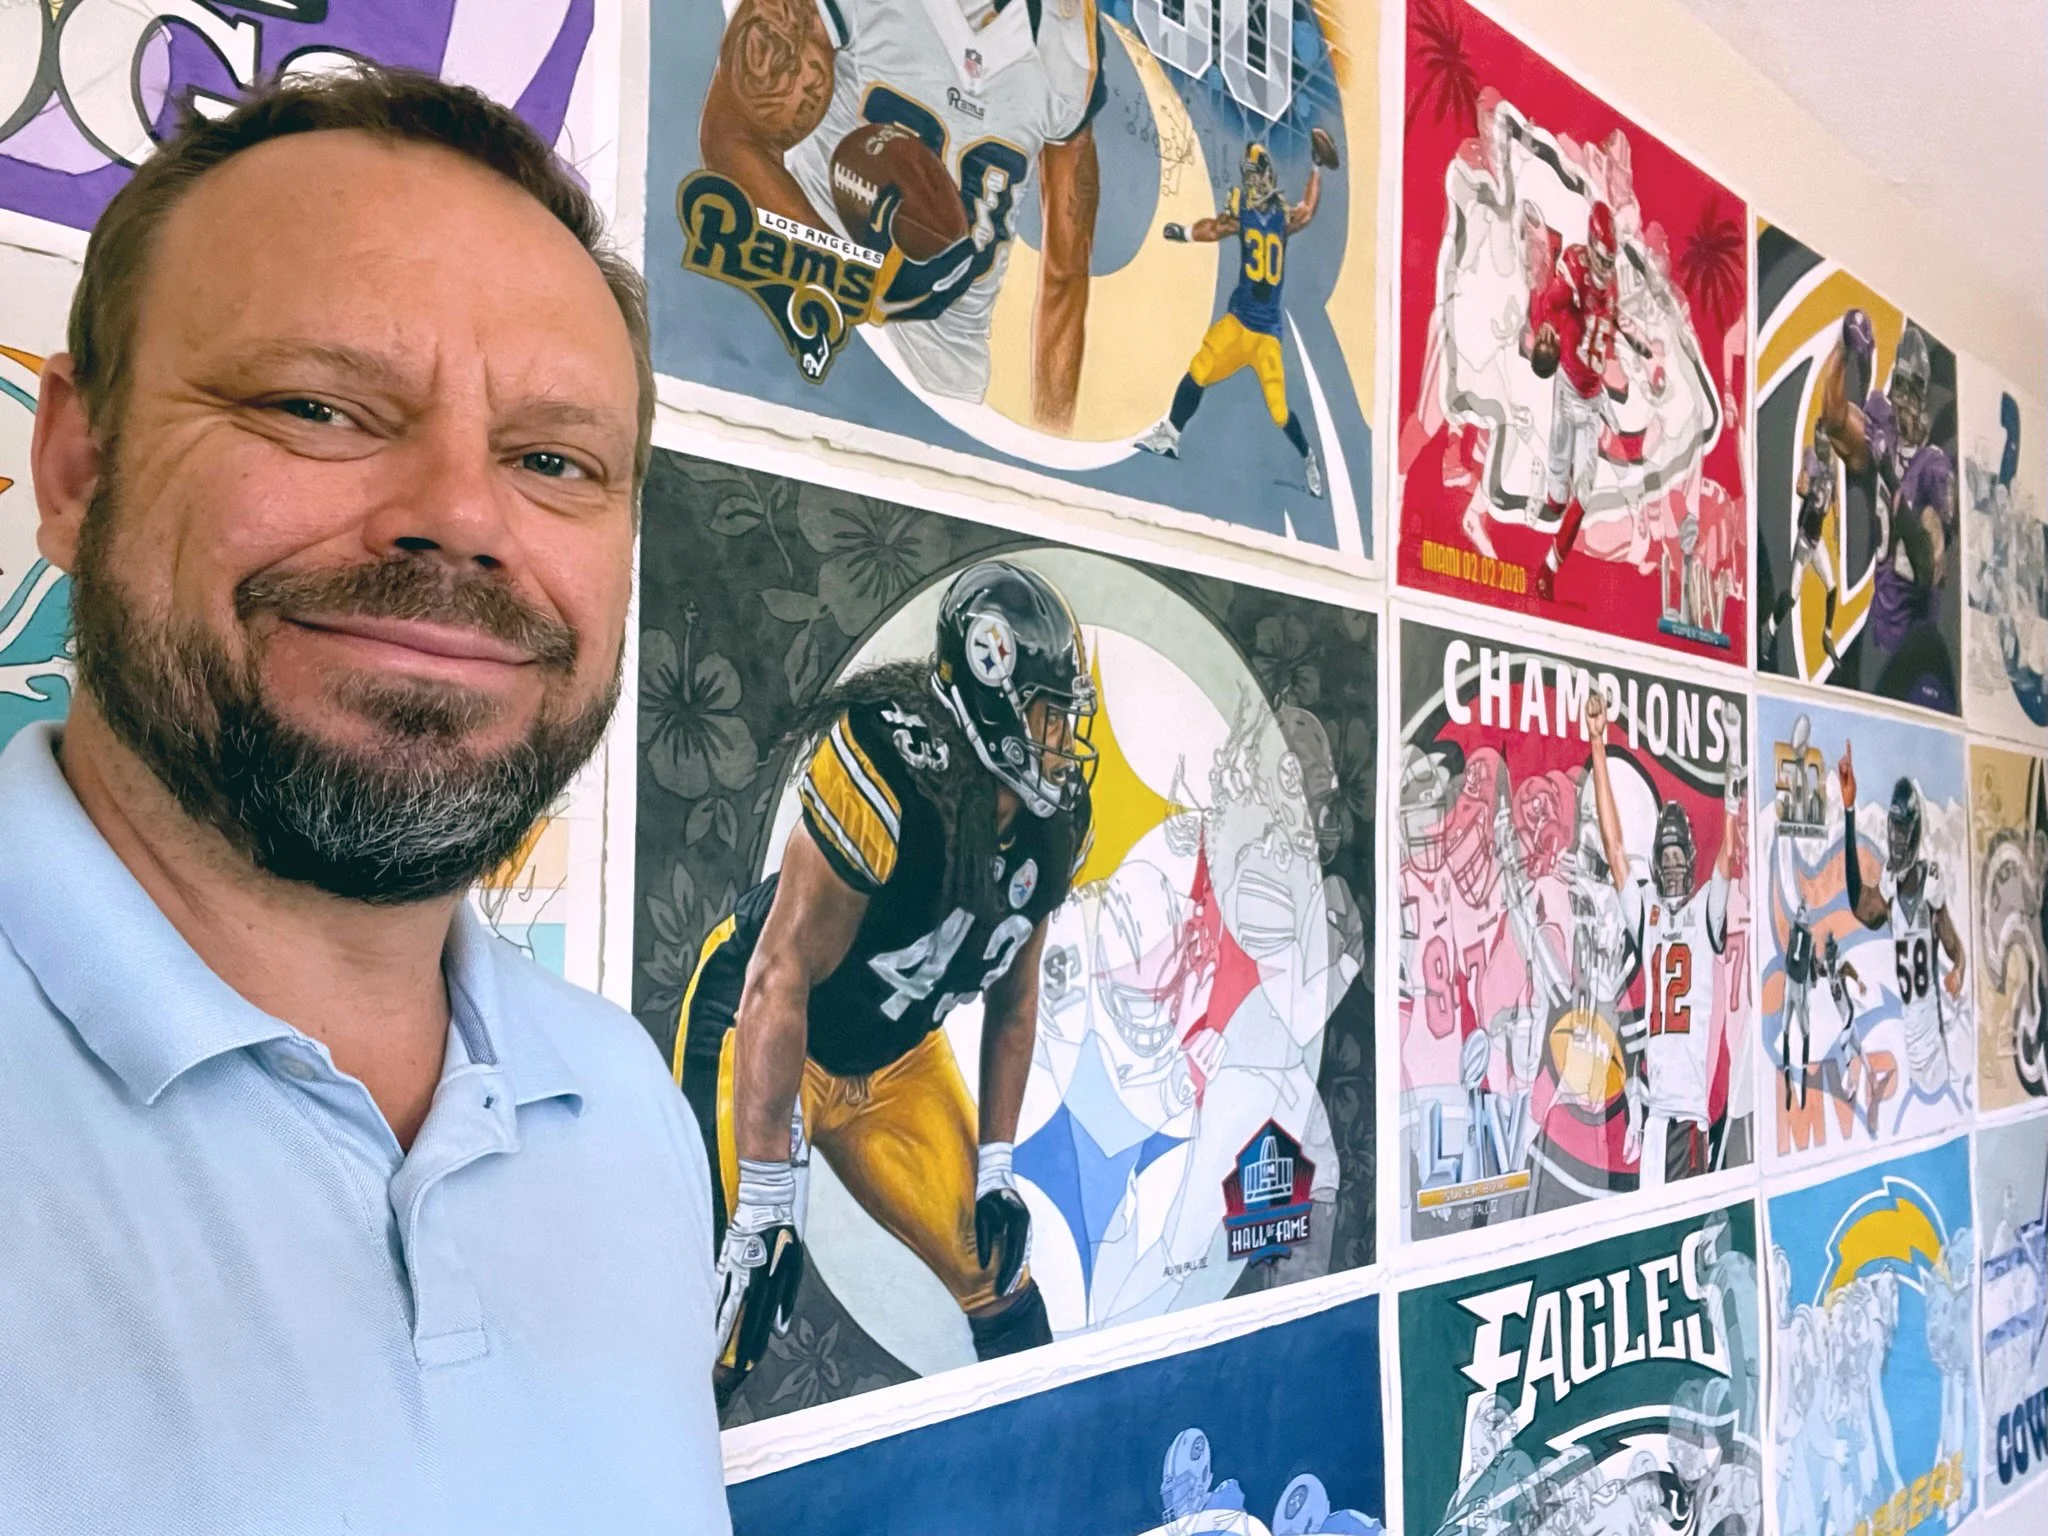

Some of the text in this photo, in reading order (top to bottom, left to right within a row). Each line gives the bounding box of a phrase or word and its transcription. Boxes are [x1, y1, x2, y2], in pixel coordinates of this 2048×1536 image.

[682, 175, 877, 306] Rams
[764, 212, 882, 265] LOS ANGELES
[1244, 227, 1284, 287] 30
[1422, 539, 1526, 594] MIAMI 02 02 2020
[1443, 639, 1725, 763] CHAMPIONS
[1649, 942, 1692, 1039] 12
[1895, 937, 1929, 1005] 58
[1776, 1050, 1898, 1157] MVP
[1231, 1225, 1268, 1253] HALL
[1275, 1216, 1310, 1244] FAME
[1454, 1225, 1732, 1462] EAGLES
